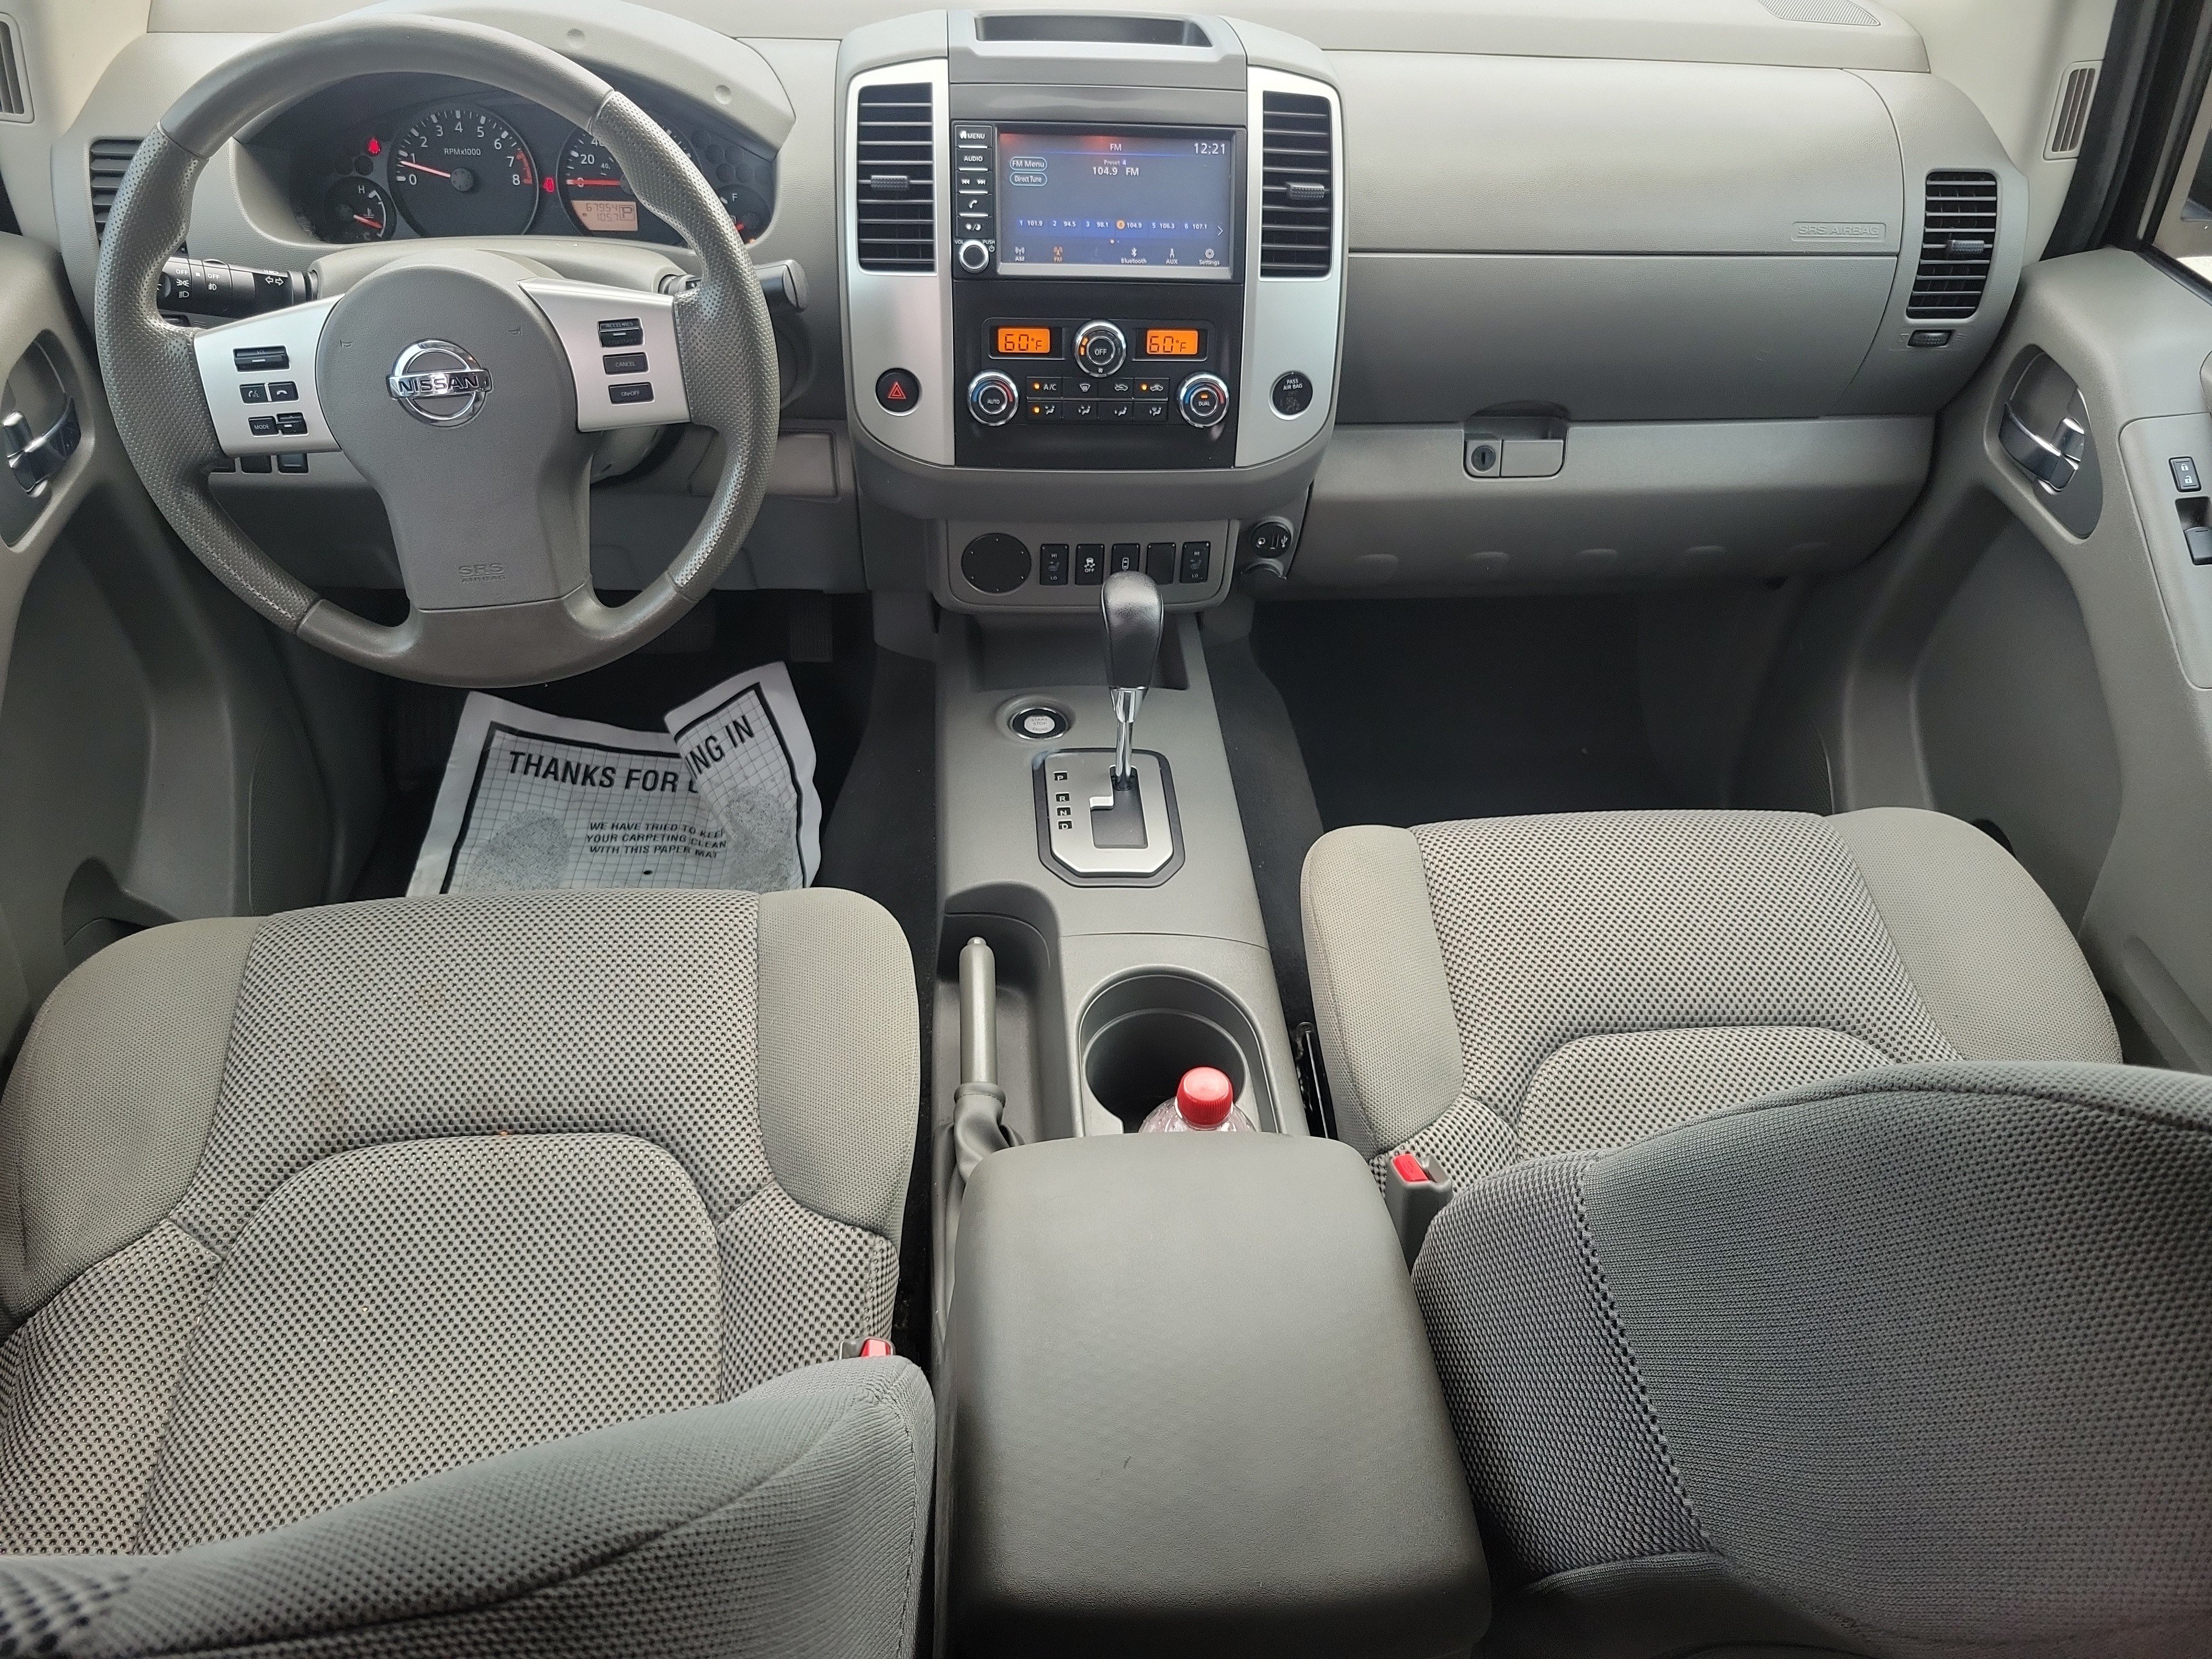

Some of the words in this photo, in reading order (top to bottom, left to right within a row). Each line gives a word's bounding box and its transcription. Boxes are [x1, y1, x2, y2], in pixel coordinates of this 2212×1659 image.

[437, 126, 443, 137] 3
[455, 122, 463, 133] 4
[477, 126, 484, 137] 5
[420, 137, 428, 148] 2
[494, 139, 502, 150] 6
[1109, 143, 1122, 151] FM
[1193, 143, 1226, 155] 12:21
[411, 153, 416, 163] 1
[507, 156, 514, 167] 7
[580, 154, 595, 165] 20
[1012, 160, 1023, 168] FM
[1025, 160, 1045, 168] Menu
[1092, 166, 1118, 176] 104.9
[1126, 167, 1139, 176] FM
[409, 174, 417, 185] 0
[512, 174, 521, 185] 8
[1030, 175, 1042, 183] Tune
[358, 185, 365, 194] H
[732, 193, 737, 202] F
[620, 206, 633, 218] P
[1798, 225, 1827, 235] SRS
[1830, 225, 1879, 235] AIRBAG
[1094, 348, 1108, 356] OFF
[399, 375, 479, 394] NISSAN
[459, 563, 505, 575] SRS
[509, 751, 617, 788] THANKS
[625, 769, 679, 793] FOR
[725, 715, 755, 749] IN
[590, 822, 605, 831] WE
[683, 824, 696, 835] TO
[700, 828, 725, 838] KEEP
[586, 834, 618, 843] YOUR
[622, 833, 686, 843] CARPETING
[690, 839, 726, 849] CLEAN
[590, 845, 620, 854] WITH
[624, 845, 650, 854] THIS
[654, 846, 691, 854] PAPER
[695, 849, 718, 859] MAT
